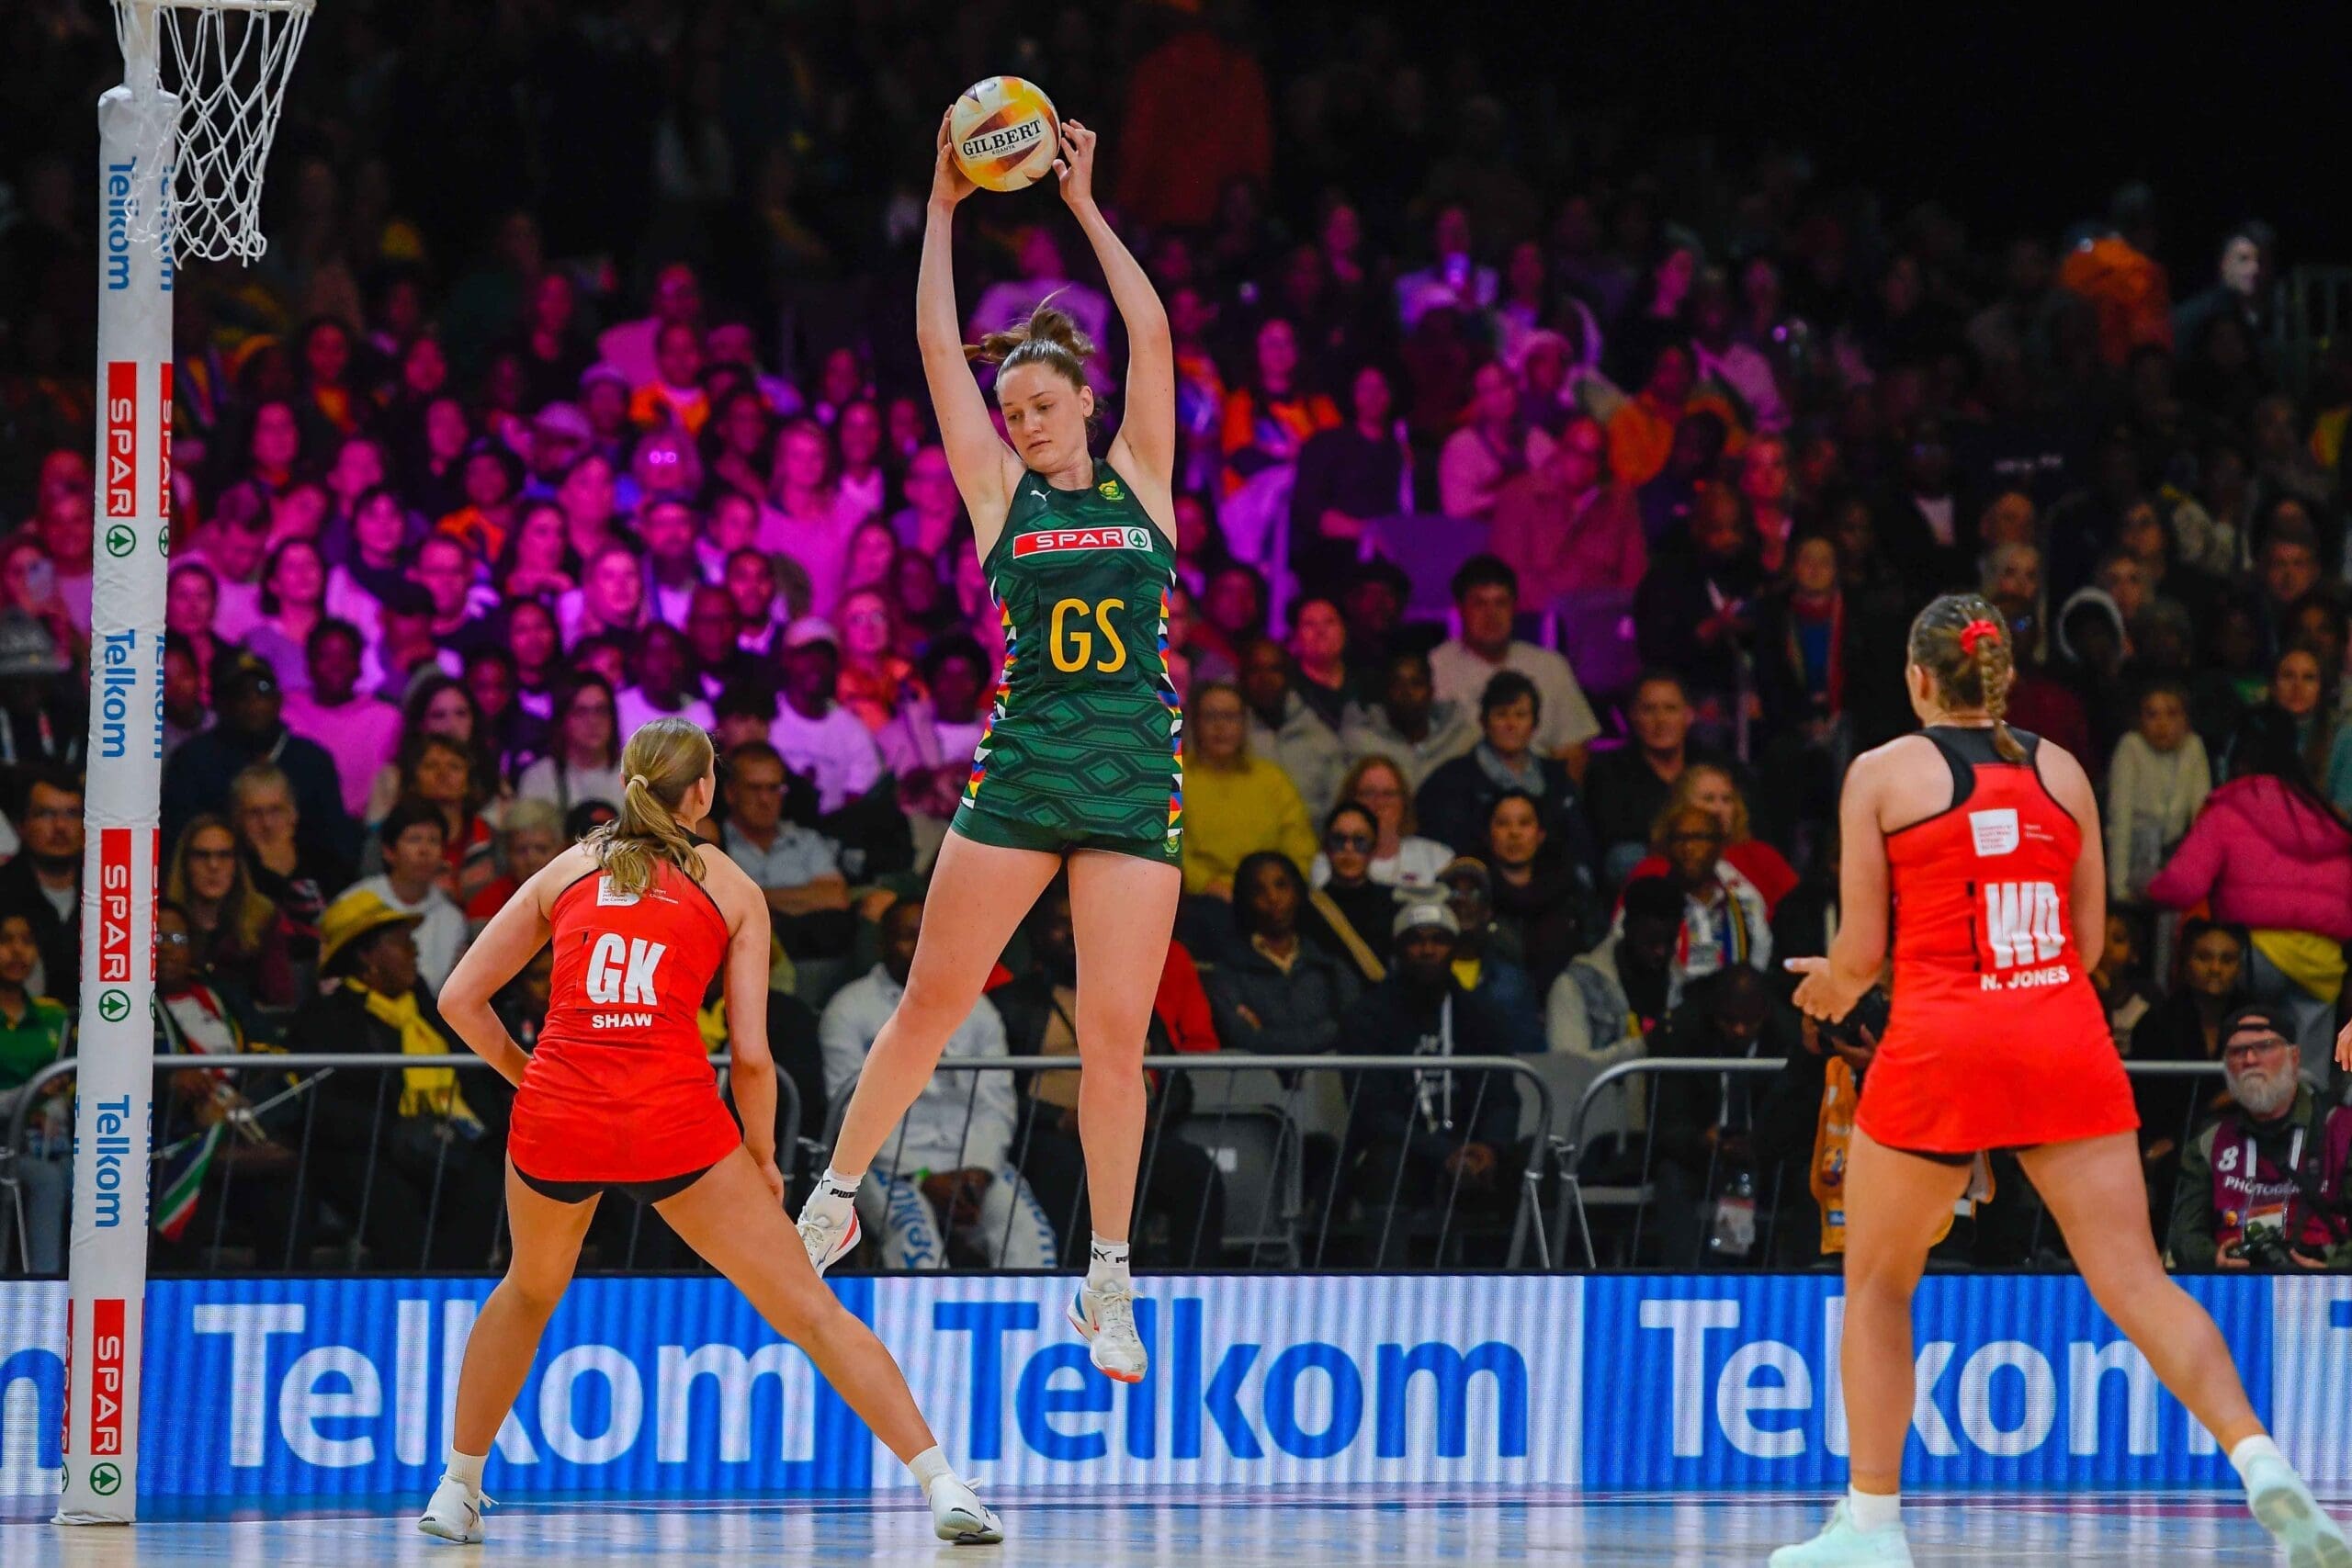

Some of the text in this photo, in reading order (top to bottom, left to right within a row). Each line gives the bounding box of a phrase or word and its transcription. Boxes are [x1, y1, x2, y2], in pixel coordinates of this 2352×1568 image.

[963, 119, 1041, 156] GILBERT
[110, 398, 132, 514] SPAR
[1036, 531, 1121, 548] SPAR
[1050, 598, 1126, 672] GS
[102, 629, 136, 758] Telkom
[104, 864, 127, 979] SPAR
[1984, 882, 2065, 969] WD
[586, 933, 666, 1006] GK
[1981, 965, 2070, 991] N. JONES
[592, 1013, 652, 1029] SHAW
[96, 1095, 130, 1227] Telkom
[2218, 1145, 2239, 1172] 8
[96, 1336, 120, 1452] SPAR
[933, 1297, 1528, 1461] Telkom
